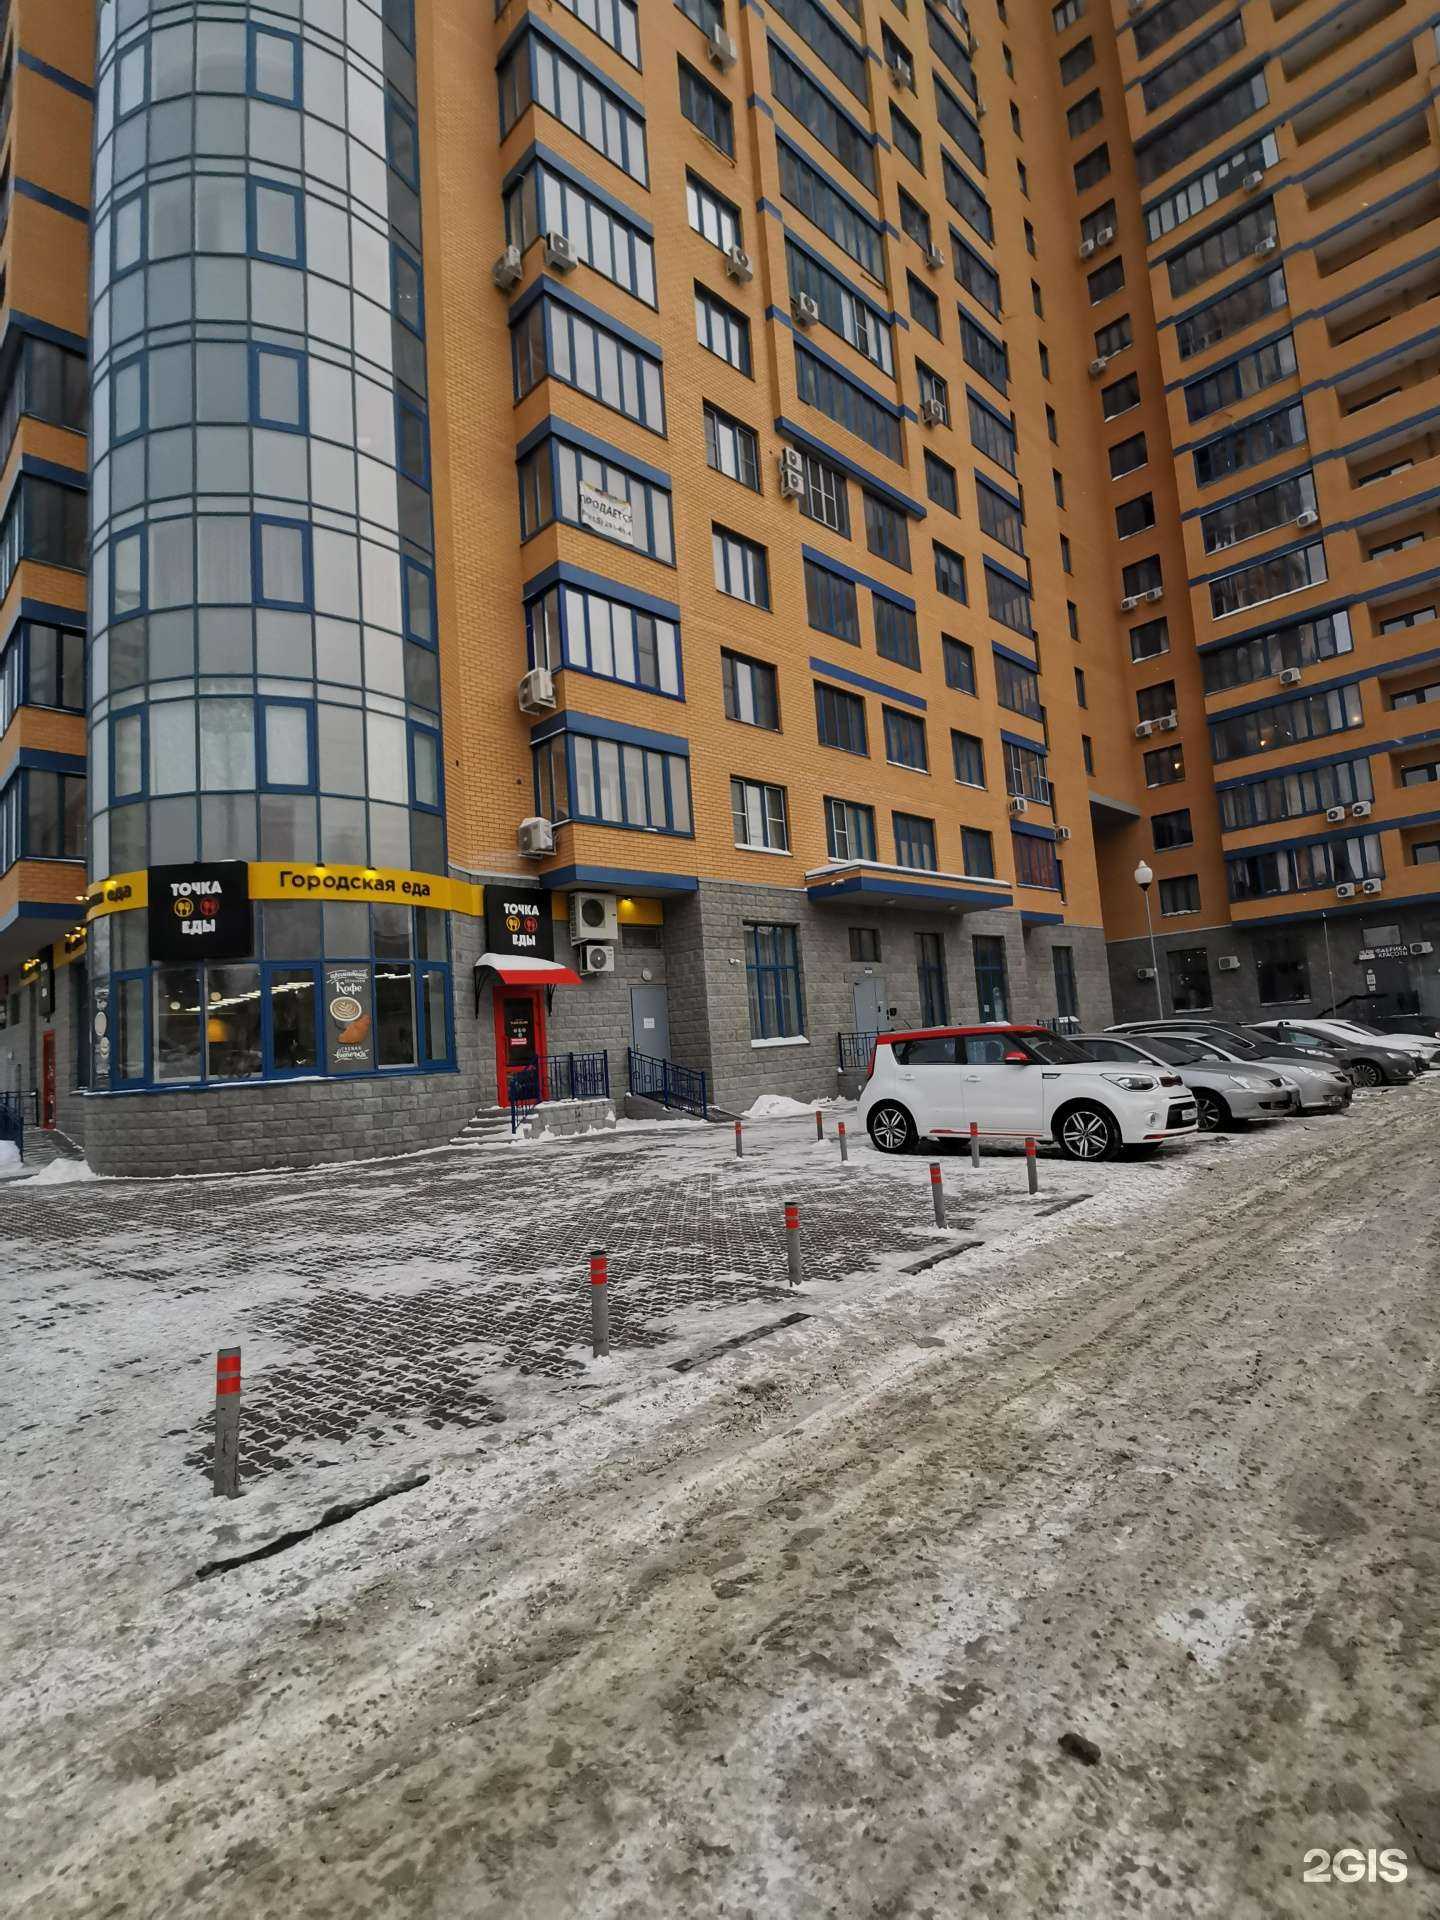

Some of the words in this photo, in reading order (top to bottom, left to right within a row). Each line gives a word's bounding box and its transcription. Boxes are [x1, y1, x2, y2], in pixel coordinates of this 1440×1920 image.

[170, 880, 222, 896] ТОЧКА
[279, 871, 396, 891] Городская
[402, 880, 431, 897] еда
[503, 902, 540, 916] ТОЧКА
[182, 919, 216, 935] ЕДЫ
[512, 934, 536, 947] ЕДЫ
[336, 982, 362, 995] Кофе
